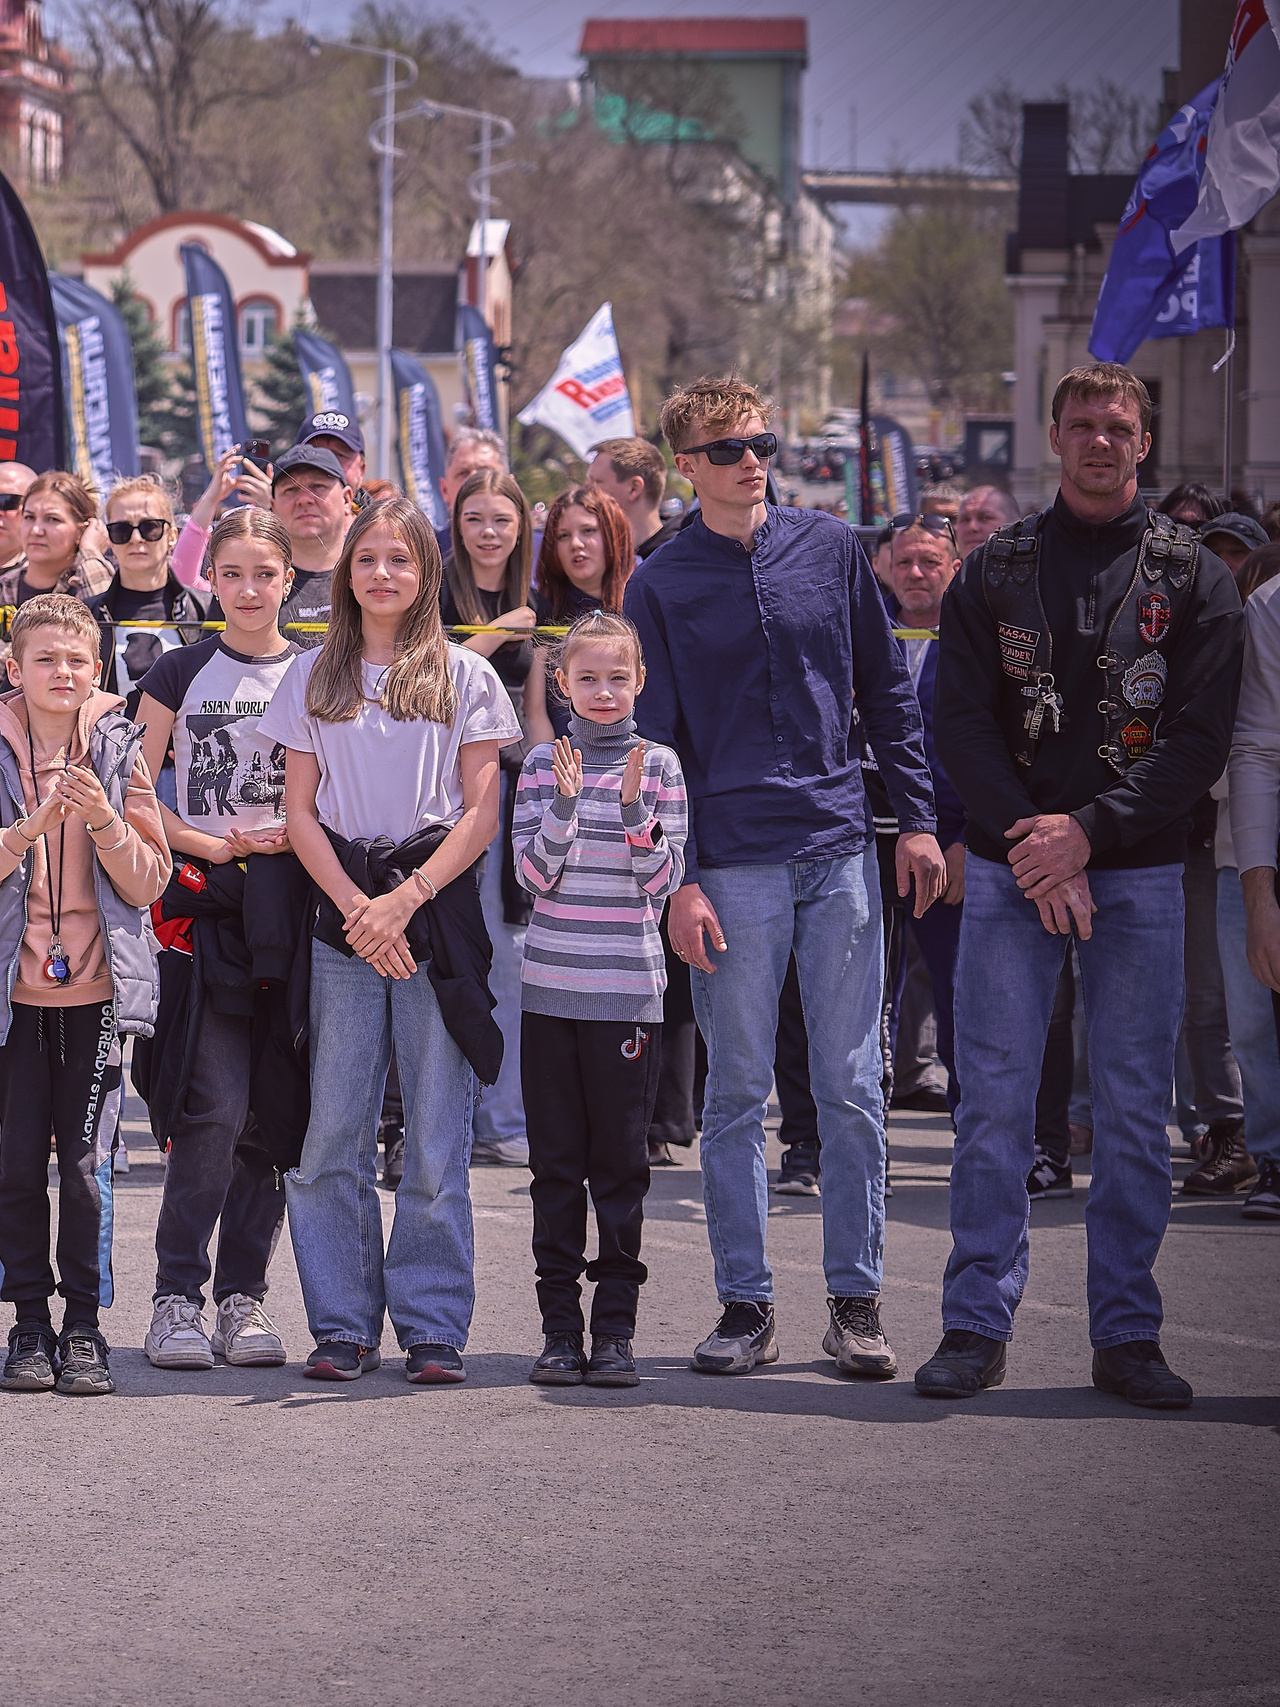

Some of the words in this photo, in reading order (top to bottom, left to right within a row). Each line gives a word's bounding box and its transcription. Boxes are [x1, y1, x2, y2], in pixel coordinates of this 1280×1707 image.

[200, 700, 230, 714] ASIAN
[92, 1031, 113, 1081] READY
[81, 1083, 101, 1144] STEADY
